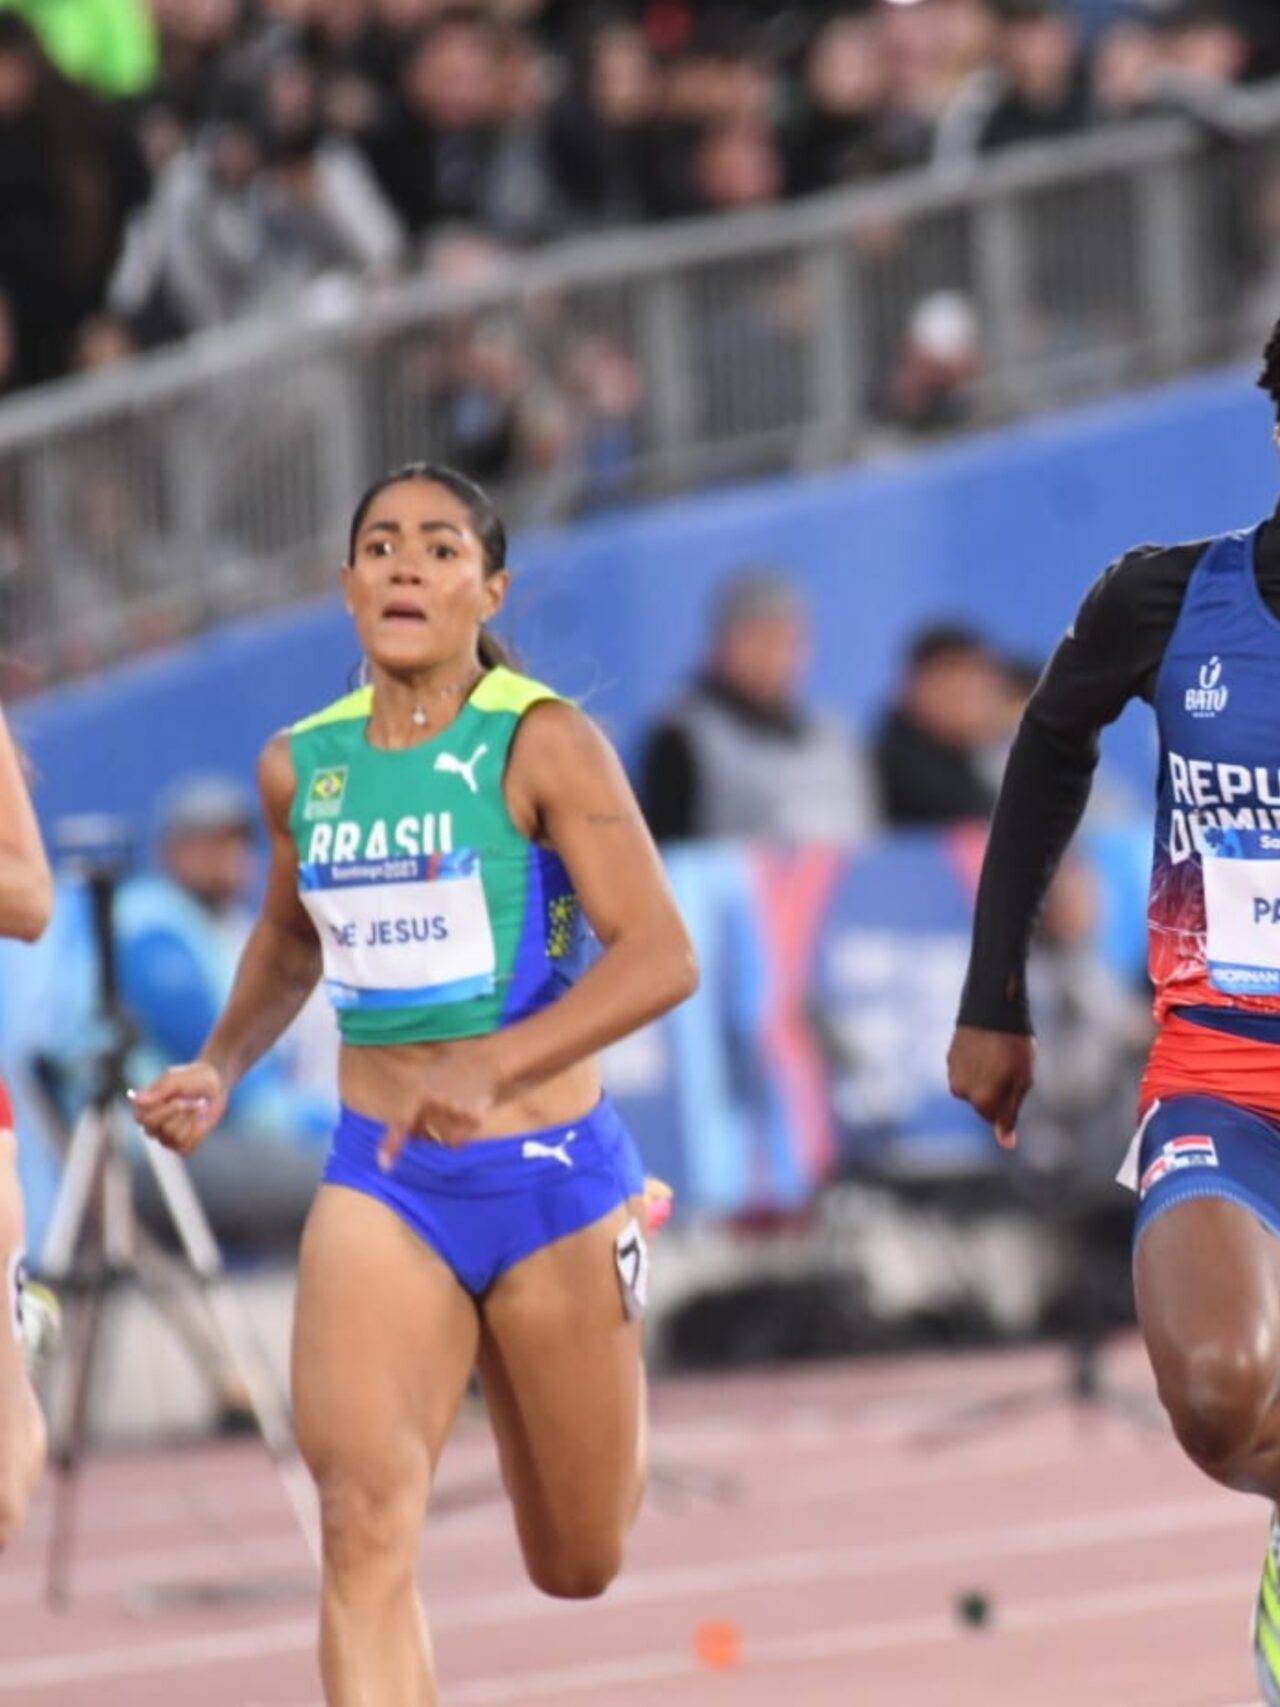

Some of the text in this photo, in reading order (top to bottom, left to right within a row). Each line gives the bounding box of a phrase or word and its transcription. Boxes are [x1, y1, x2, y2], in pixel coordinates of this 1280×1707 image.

[307, 811, 454, 865] BRASIL
[366, 916, 449, 946] JESUS
[619, 1237, 641, 1293] 7
